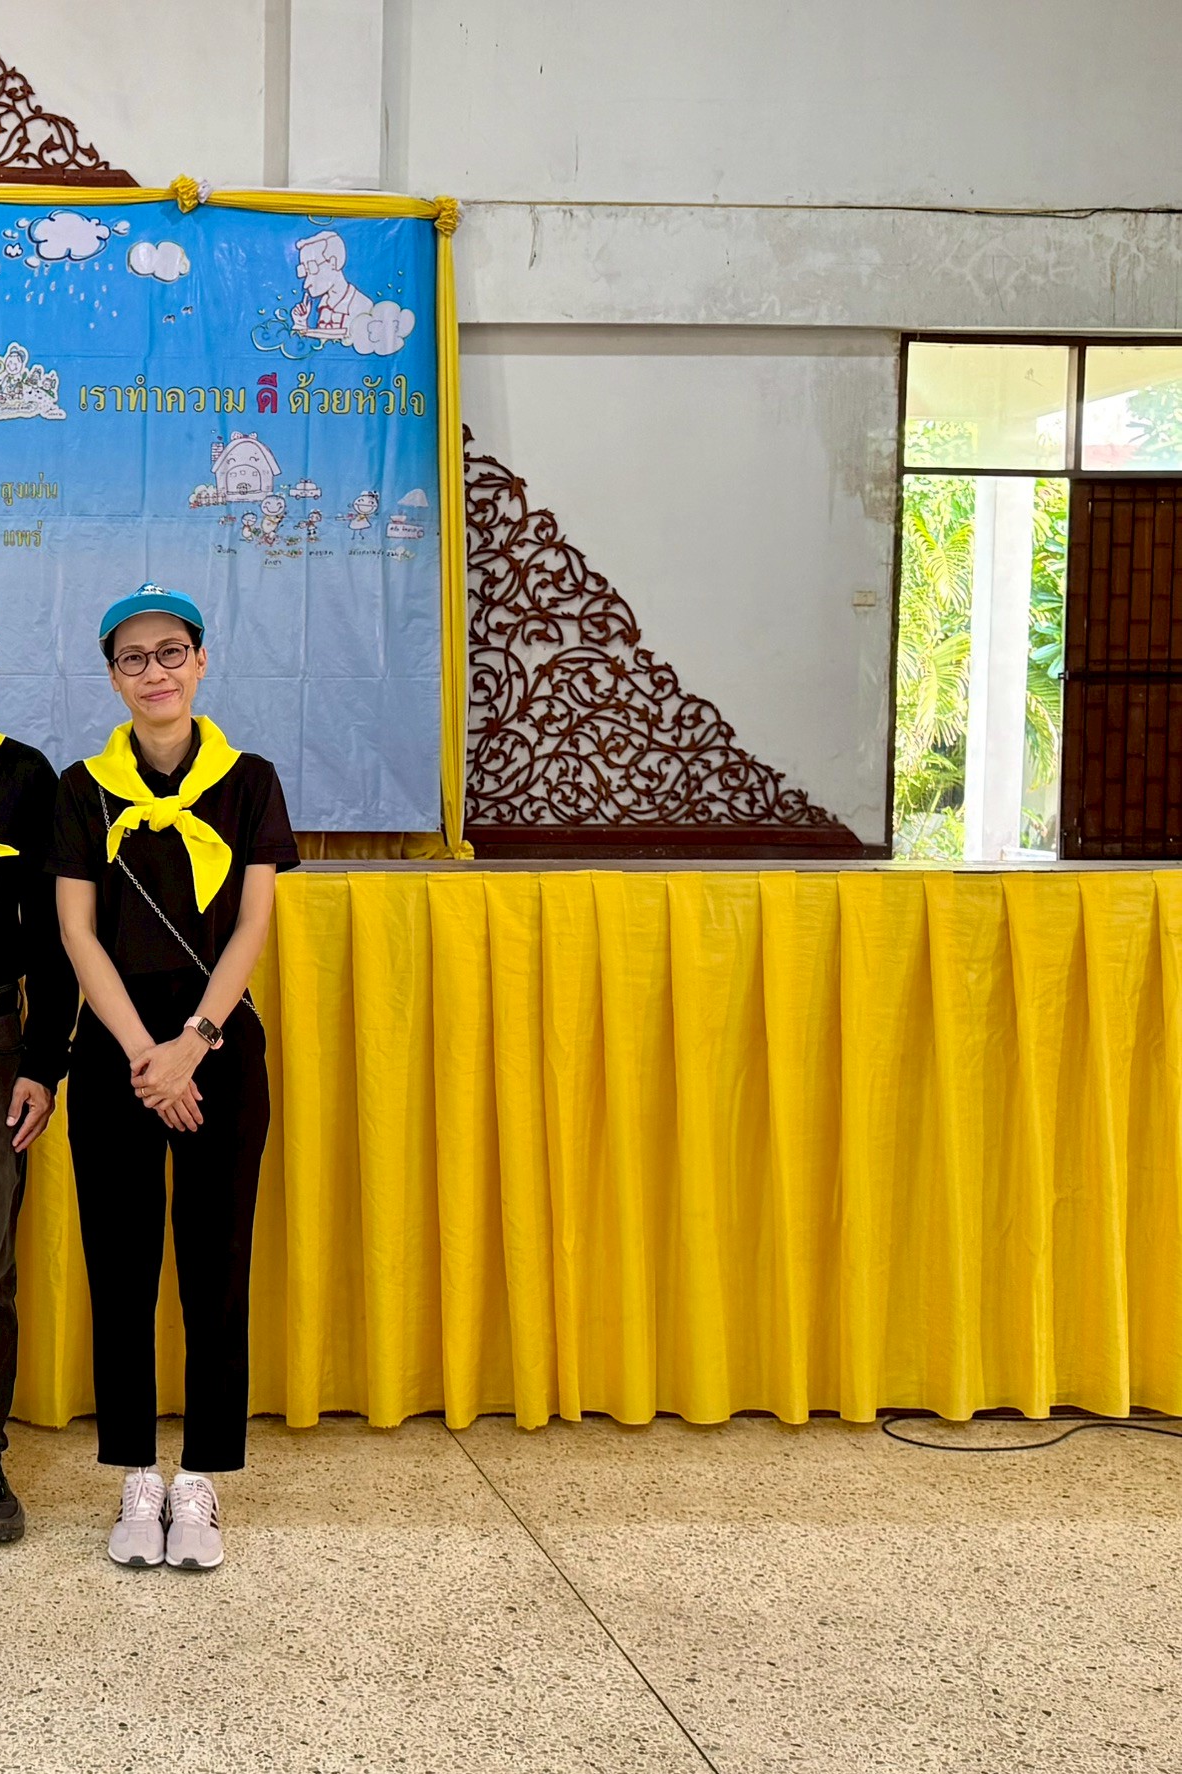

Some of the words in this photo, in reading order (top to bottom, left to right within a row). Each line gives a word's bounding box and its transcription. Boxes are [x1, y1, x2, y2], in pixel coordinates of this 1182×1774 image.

[78, 373, 246, 414] เราทำความ
[255, 371, 279, 415] ดี
[288, 371, 427, 418] ด้วยหัวใจ
[2, 519, 44, 548] แพร่
